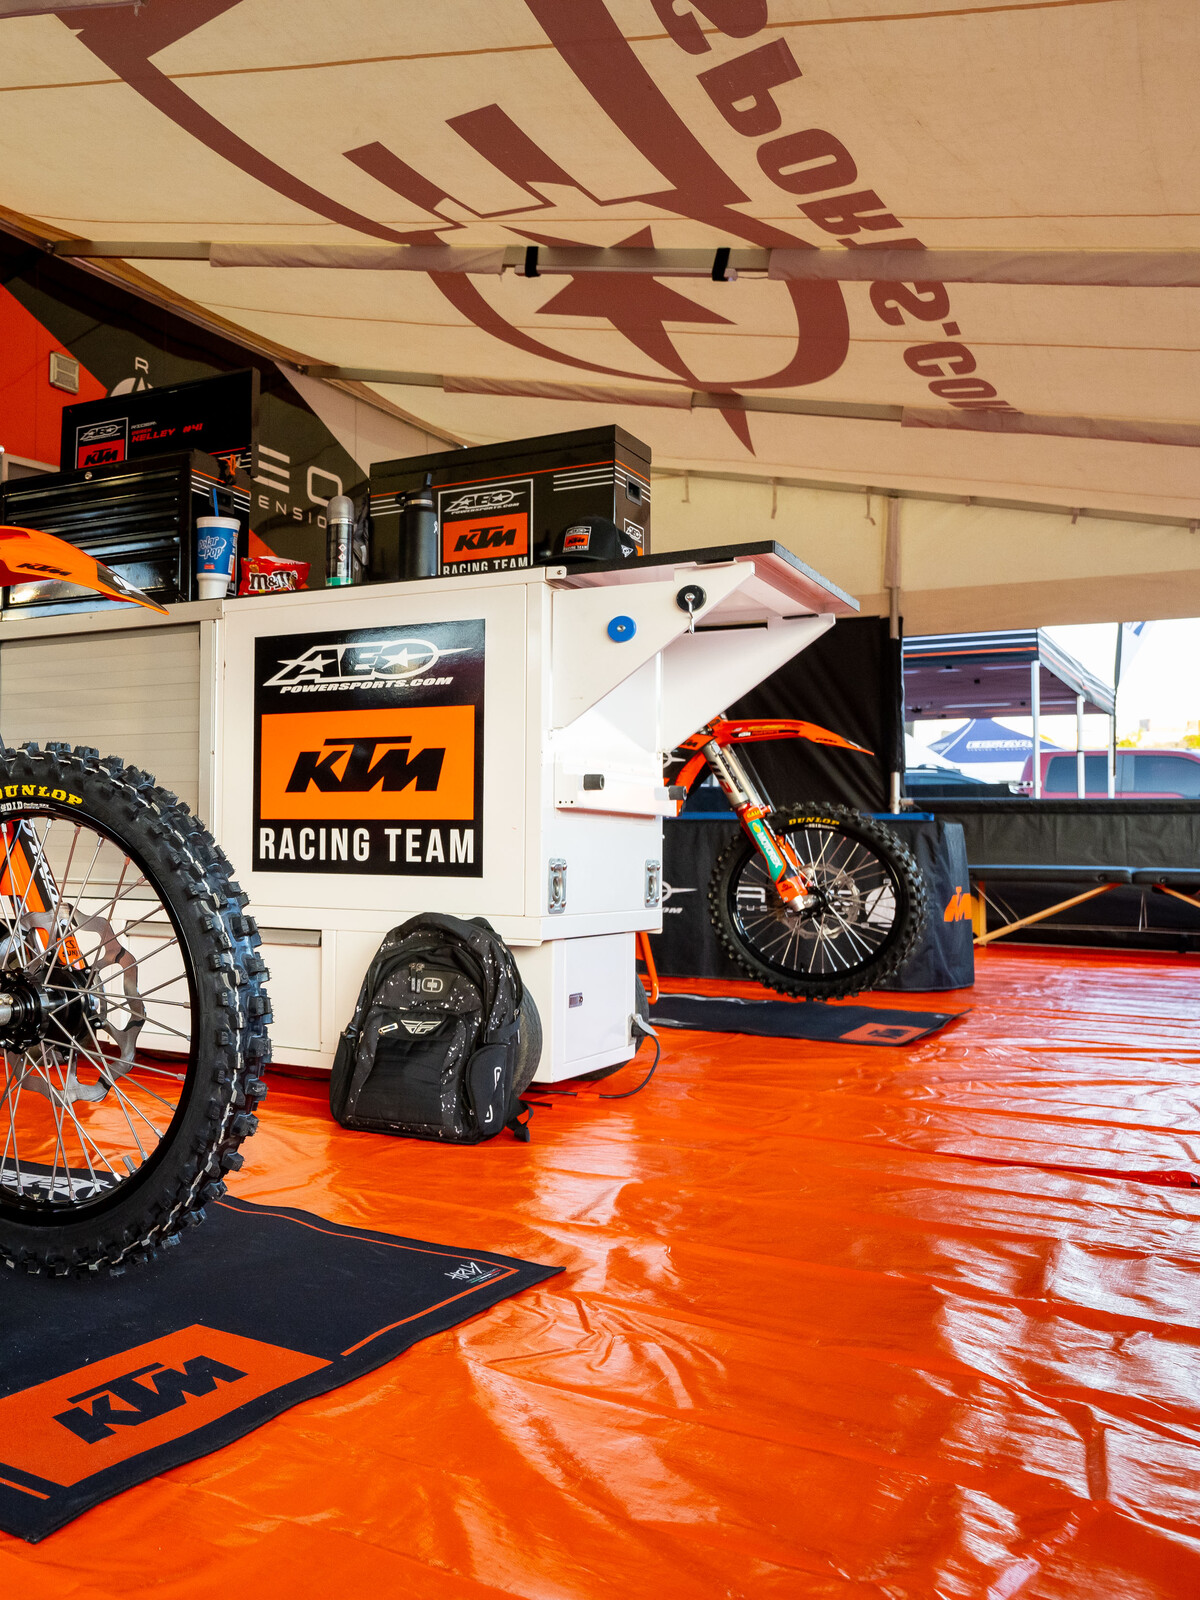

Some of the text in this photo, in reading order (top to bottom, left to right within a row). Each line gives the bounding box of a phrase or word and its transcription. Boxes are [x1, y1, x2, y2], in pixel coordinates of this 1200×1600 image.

[135, 357, 150, 375] R
[131, 428, 176, 443] KELLEY
[182, 422, 203, 434] #41
[83, 447, 119, 466] KTM
[450, 502, 520, 515] POWERSPORTS.COM
[453, 525, 517, 552] KTM
[442, 556, 528, 576] RACING TEAM
[279, 676, 454, 694] POWERSPORTS.COM
[284, 735, 446, 793] KTM
[788, 816, 841, 826] DUNLOP
[259, 827, 474, 864] RACING TEAM
[755, 831, 783, 869] MOTOREX
[52, 1355, 249, 1445] KTM
